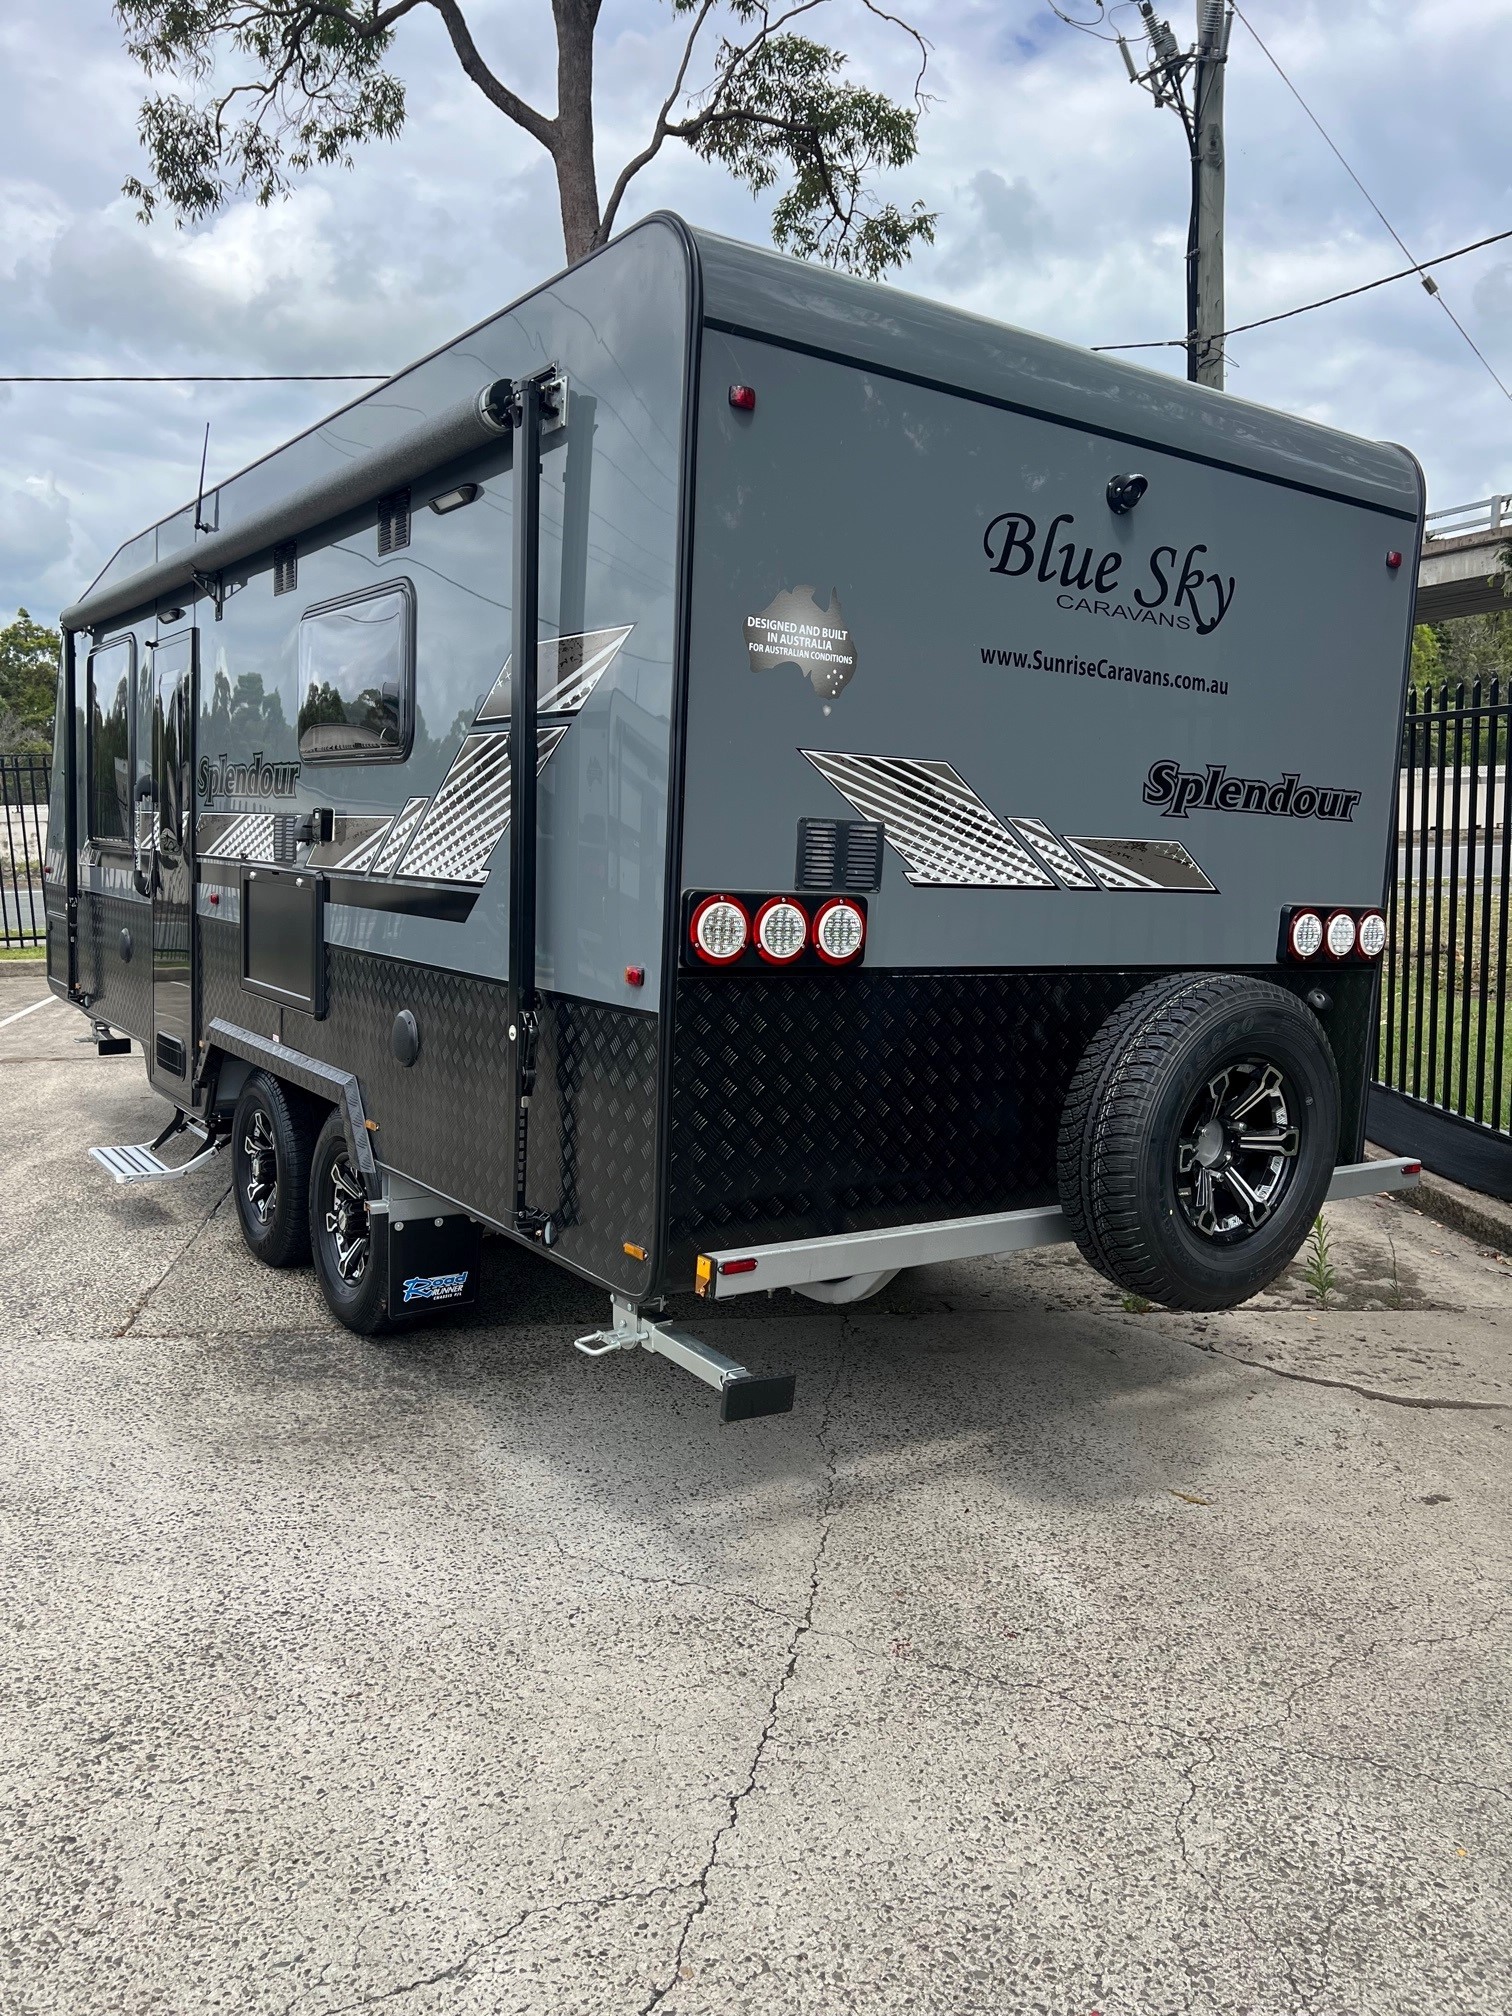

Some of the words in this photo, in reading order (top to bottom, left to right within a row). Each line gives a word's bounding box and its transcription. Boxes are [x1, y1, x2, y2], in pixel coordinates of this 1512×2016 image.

[983, 512, 1122, 593] Blue
[1134, 544, 1235, 635] Sky
[747, 616, 797, 633] DESIGNED
[799, 624, 820, 636] AND
[822, 628, 848, 640] BUILT
[1056, 594, 1190, 630] CARAVANS
[749, 642, 764, 652] FOR
[765, 645, 809, 659] AUSTRALIAN
[811, 651, 853, 664] CONDITIONS
[767, 632, 778, 643] IN
[780, 634, 832, 651] AUSTRALIA
[980, 648, 1229, 695] www.SunriseCaravans.com.au
[197, 751, 301, 806] Splendour
[1142, 759, 1362, 822] Splendour
[403, 1271, 468, 1302] Road
[432, 1285, 464, 1296] RUNNER
